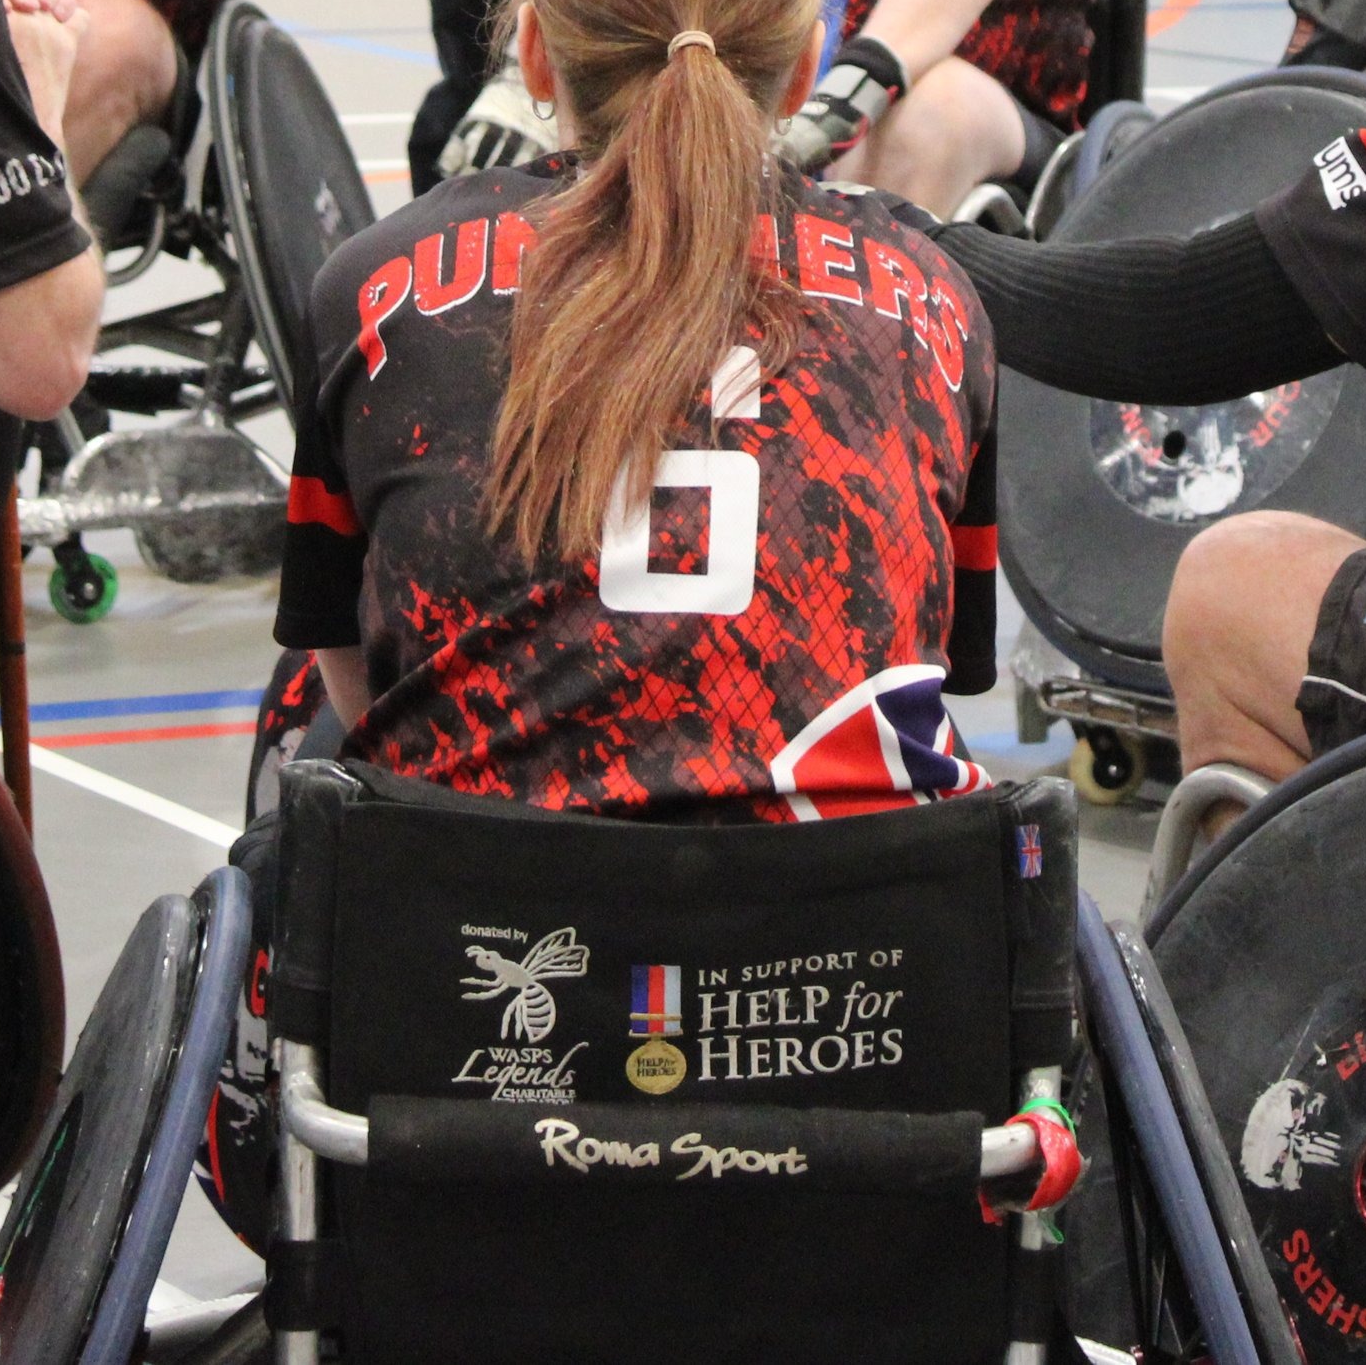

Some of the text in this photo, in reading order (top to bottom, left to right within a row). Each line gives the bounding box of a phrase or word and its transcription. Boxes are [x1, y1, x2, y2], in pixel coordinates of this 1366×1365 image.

[598, 345, 762, 616] 6
[461, 923, 529, 944] donated by
[698, 949, 904, 987] IN SUPPORT OF
[698, 981, 904, 1033] HELP for
[451, 1041, 590, 1101] Legends
[488, 1046, 554, 1064] WASPS
[698, 1029, 904, 1082] HEROES
[502, 1087, 577, 1099] CHARITABLE
[534, 1118, 809, 1181] Roma Sport
